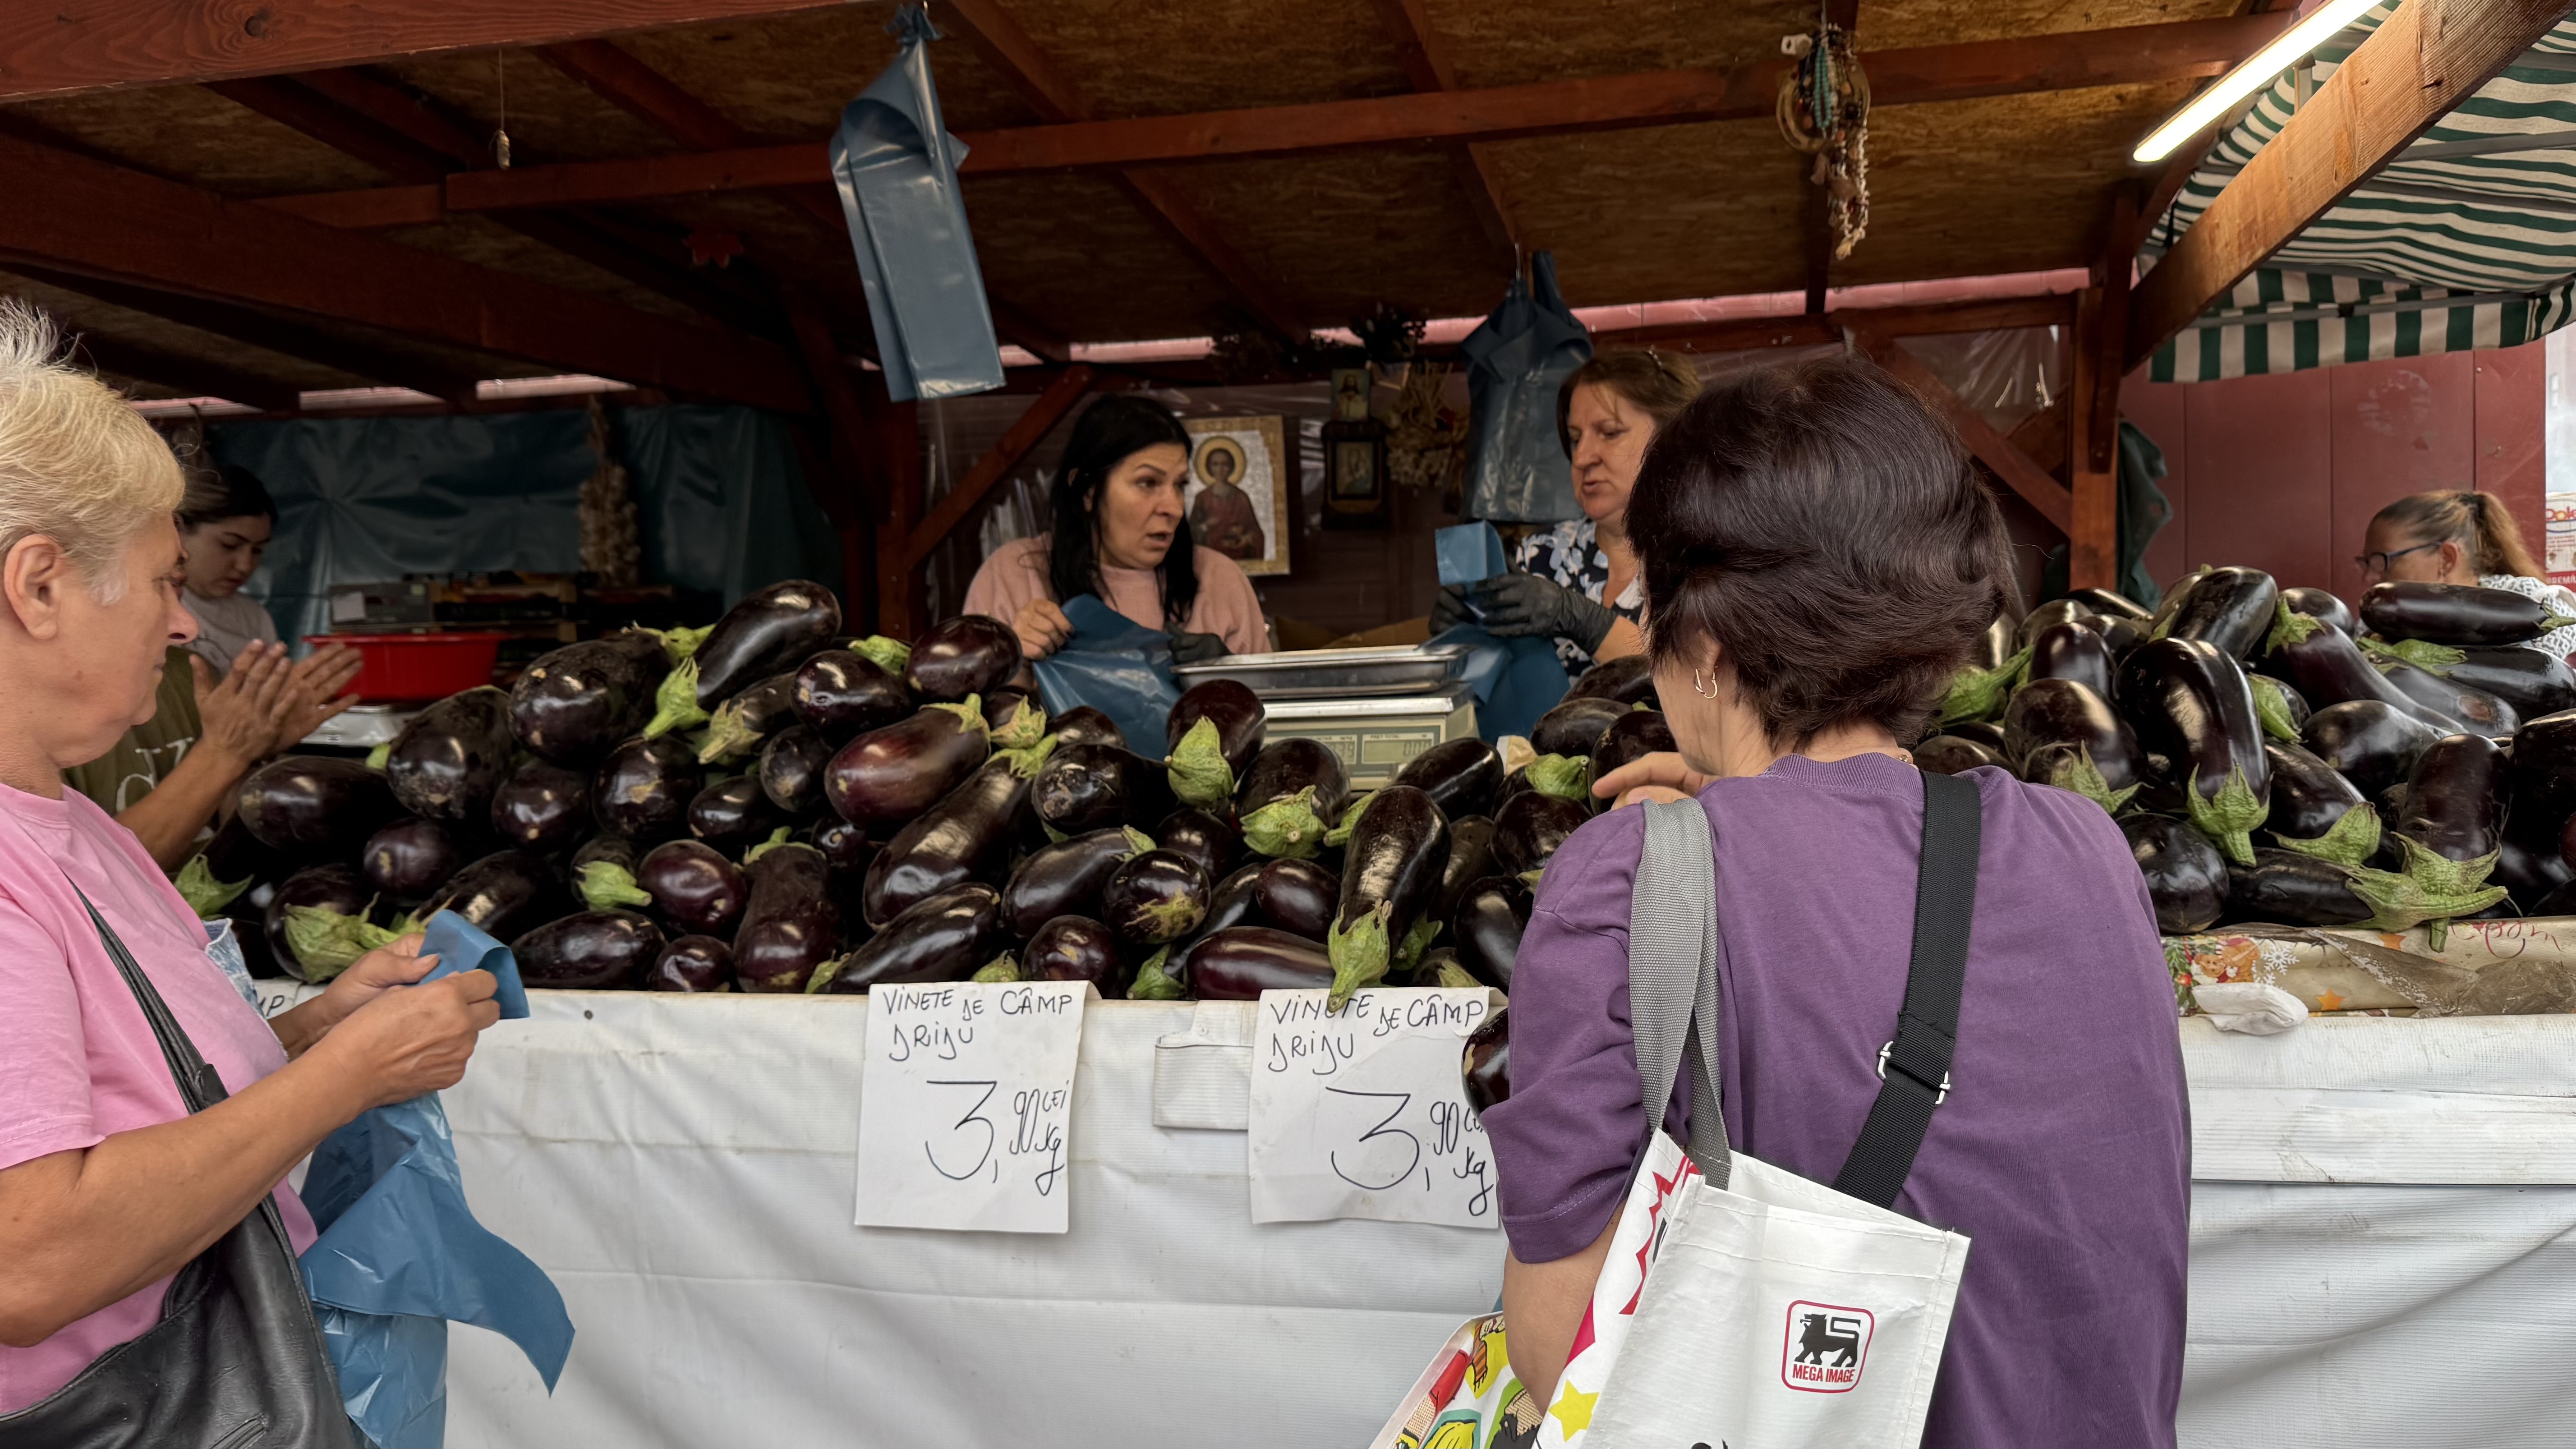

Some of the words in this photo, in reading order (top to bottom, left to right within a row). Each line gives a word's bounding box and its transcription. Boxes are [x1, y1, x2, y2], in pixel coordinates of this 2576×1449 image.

[883, 985, 954, 1015] VINETE
[1000, 987, 1072, 1014] CÂMP
[1407, 994, 1483, 1027] CÂMP
[1792, 1364, 1823, 1382] MEGA
[1825, 1368, 1855, 1383] IMAGE
